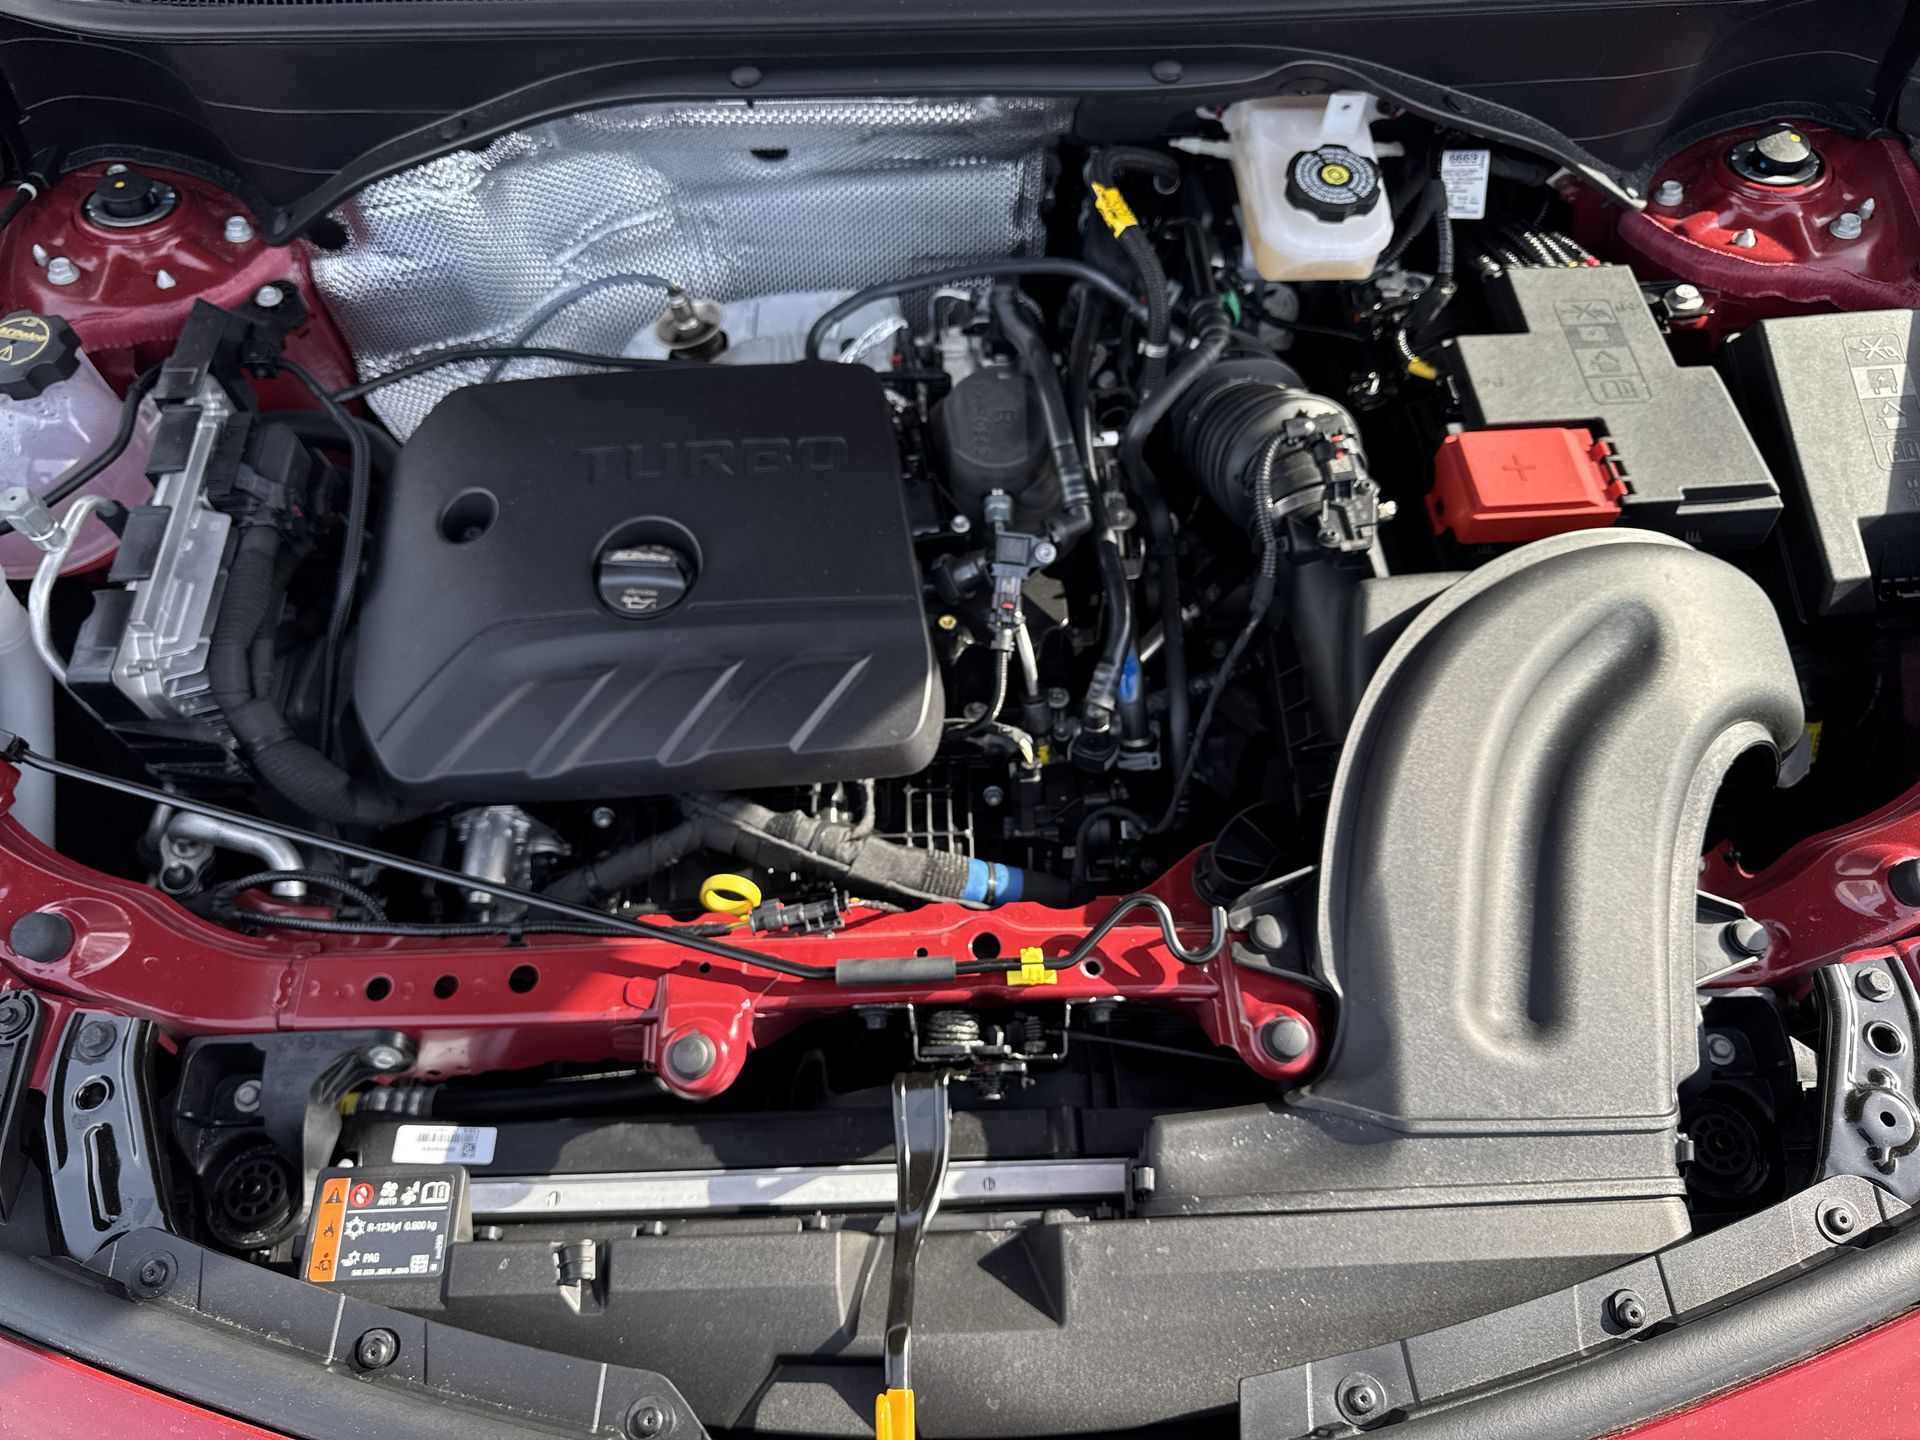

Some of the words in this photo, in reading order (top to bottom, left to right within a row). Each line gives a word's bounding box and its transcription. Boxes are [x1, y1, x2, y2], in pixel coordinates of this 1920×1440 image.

[575, 436, 849, 484] TURBO
[377, 1197, 398, 1206] AUTO
[362, 1252, 380, 1263] PAG
